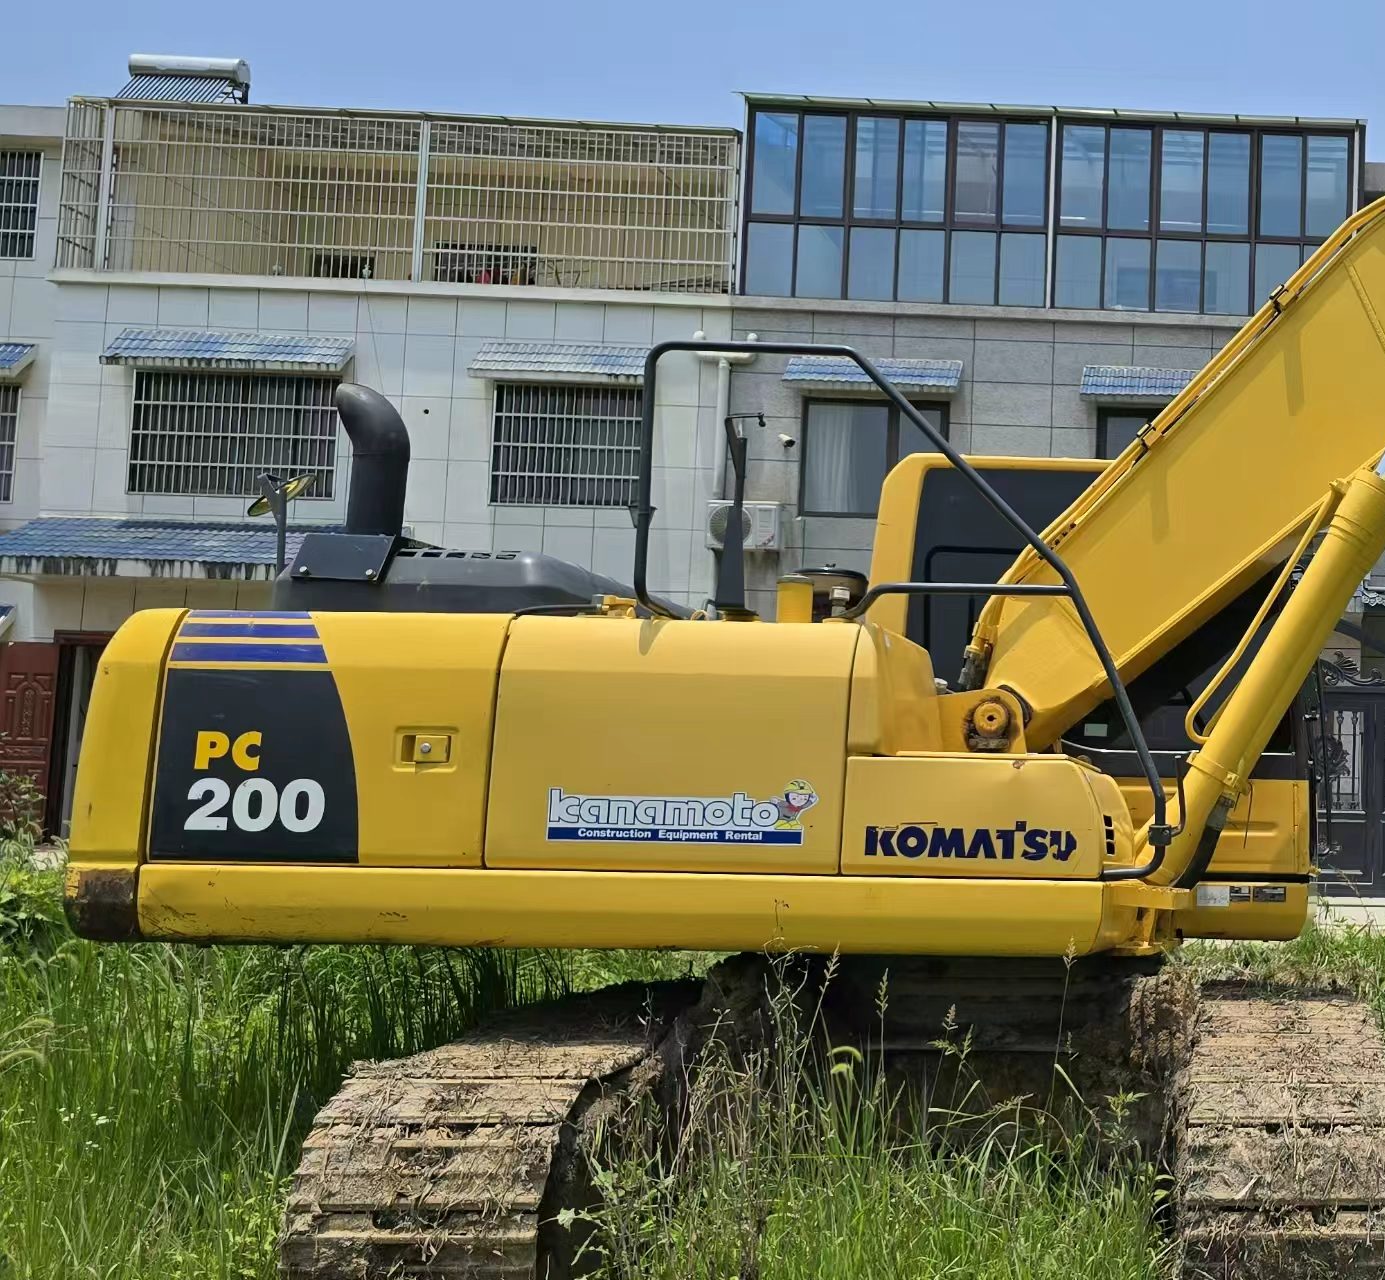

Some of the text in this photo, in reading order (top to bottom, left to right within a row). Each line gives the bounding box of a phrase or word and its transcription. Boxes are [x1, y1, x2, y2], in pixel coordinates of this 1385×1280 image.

[194, 730, 262, 770] PC
[184, 777, 325, 833] 200
[549, 788, 780, 828] kanamoto
[577, 828, 762, 841] Construction Equipment Rental
[864, 821, 1078, 862] KOMATSU
